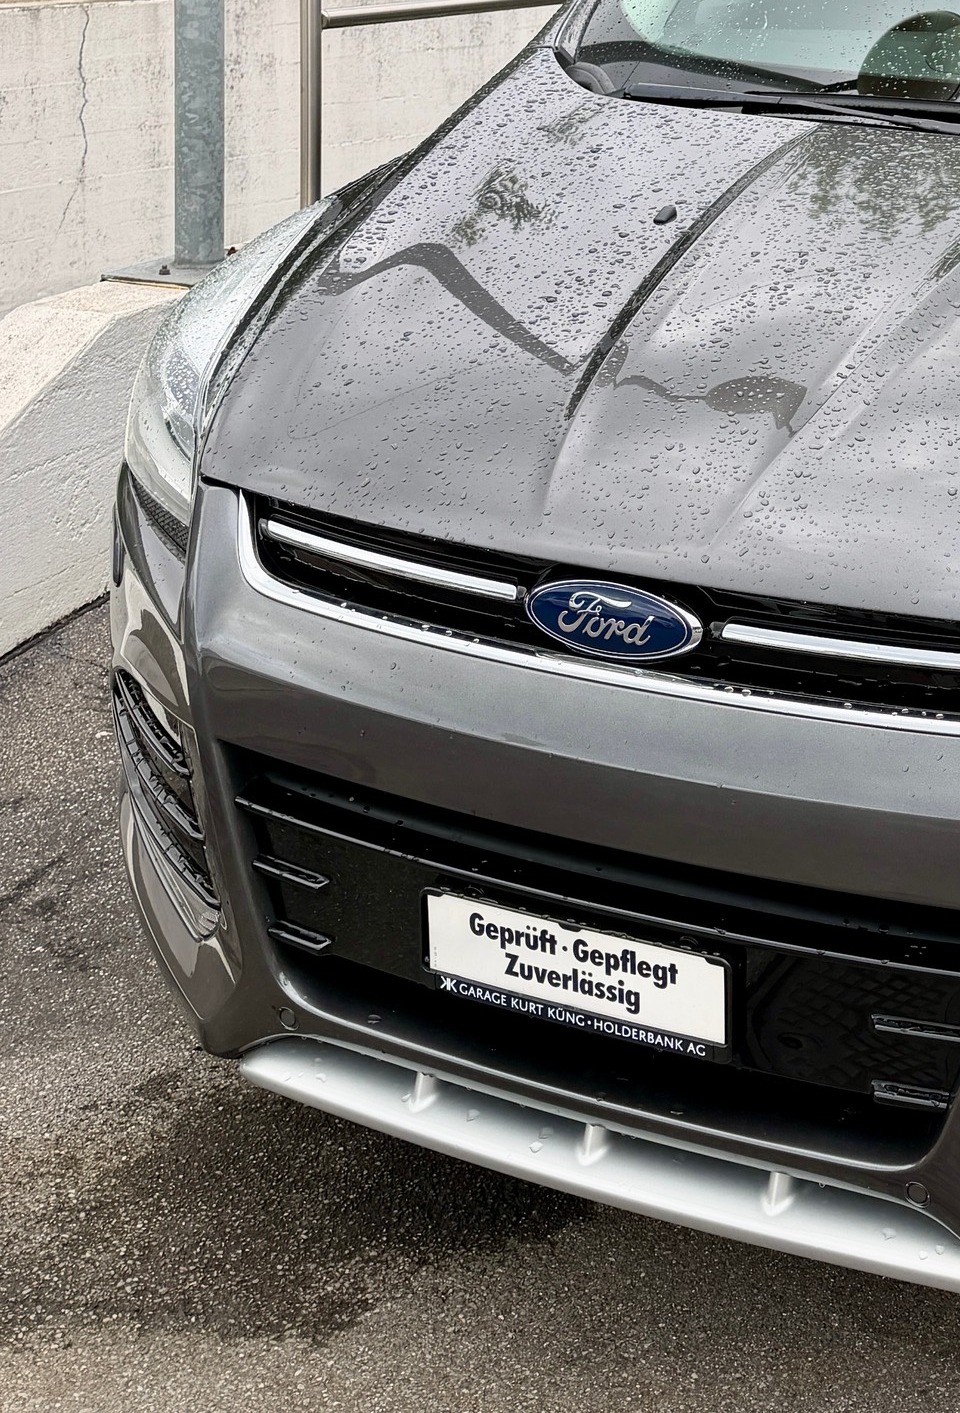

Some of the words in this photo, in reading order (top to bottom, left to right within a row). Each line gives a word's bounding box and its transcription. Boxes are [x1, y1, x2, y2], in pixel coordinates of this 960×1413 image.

[557, 591, 655, 646] Ford
[469, 912, 557, 955] Geprüft
[572, 938, 679, 989] Gepflegt
[504, 952, 640, 1015] Zuverlässig
[459, 983, 508, 1006] GARAGE
[511, 997, 544, 1016] KURT
[548, 1007, 585, 1027] KÜNG
[593, 1018, 684, 1052] HOLDERBANK
[686, 1042, 706, 1057] AG
